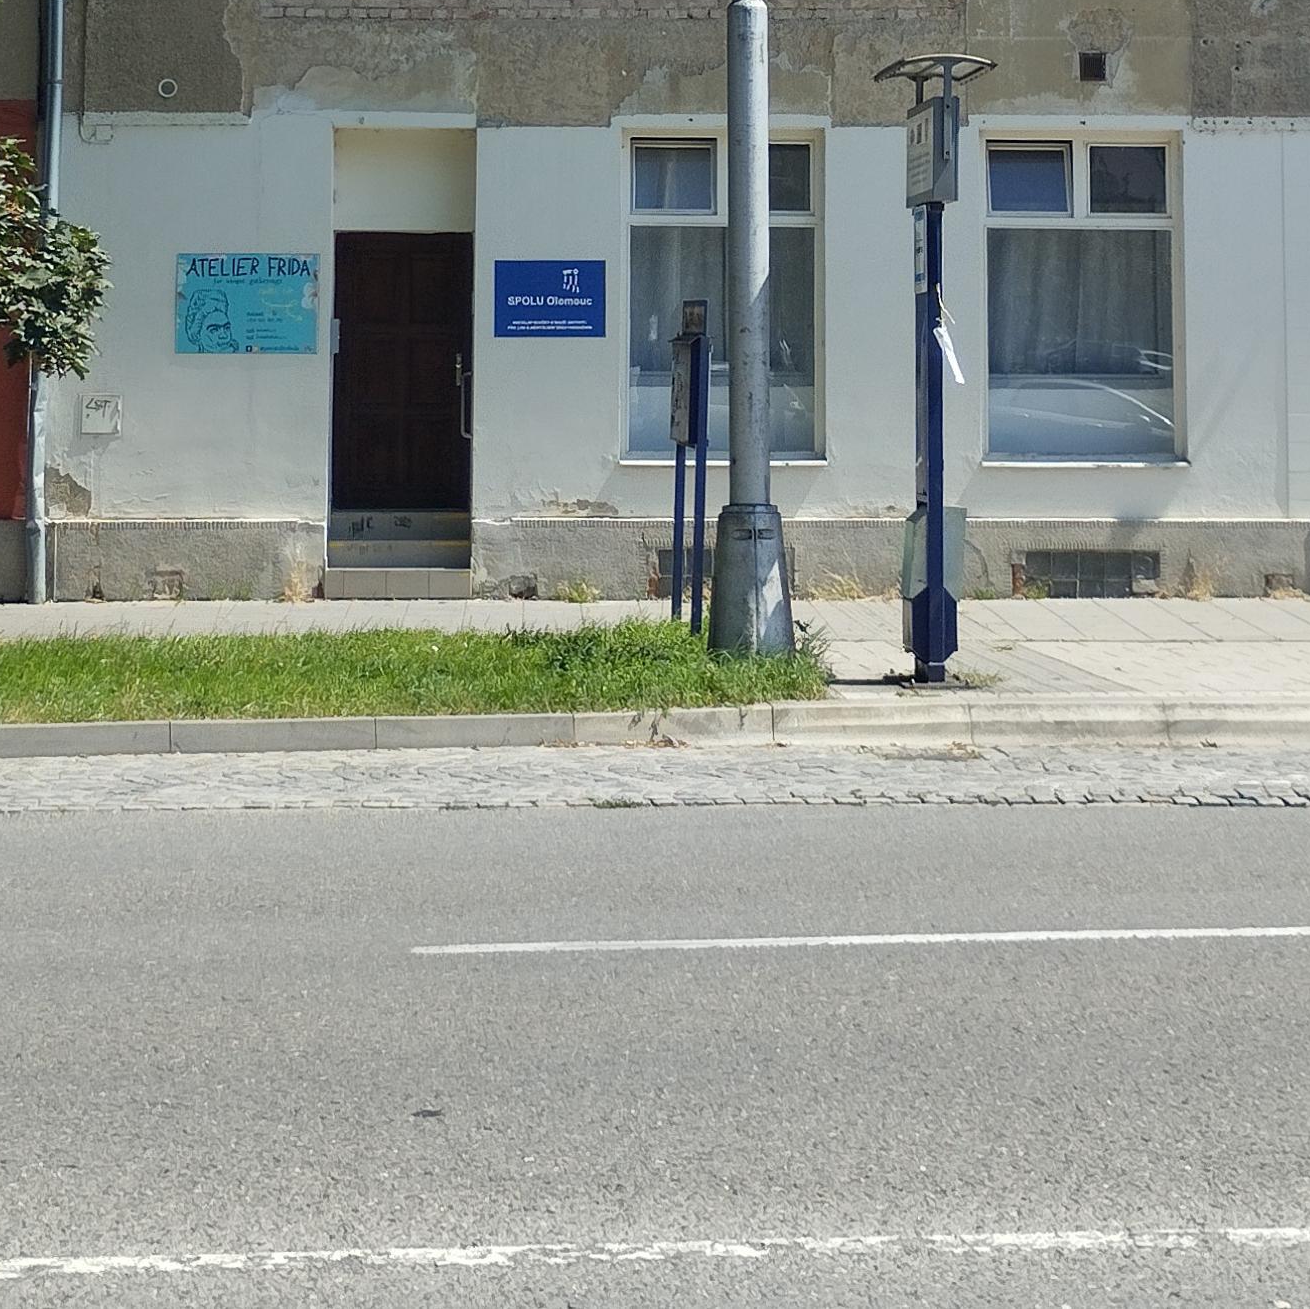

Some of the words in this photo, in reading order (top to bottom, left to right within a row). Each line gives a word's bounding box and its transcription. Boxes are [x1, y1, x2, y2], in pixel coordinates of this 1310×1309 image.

[186, 257, 259, 277] ATELIER
[268, 257, 310, 277] FRIDA
[507, 295, 544, 306] SPOLU
[546, 295, 593, 306] Olomouc
